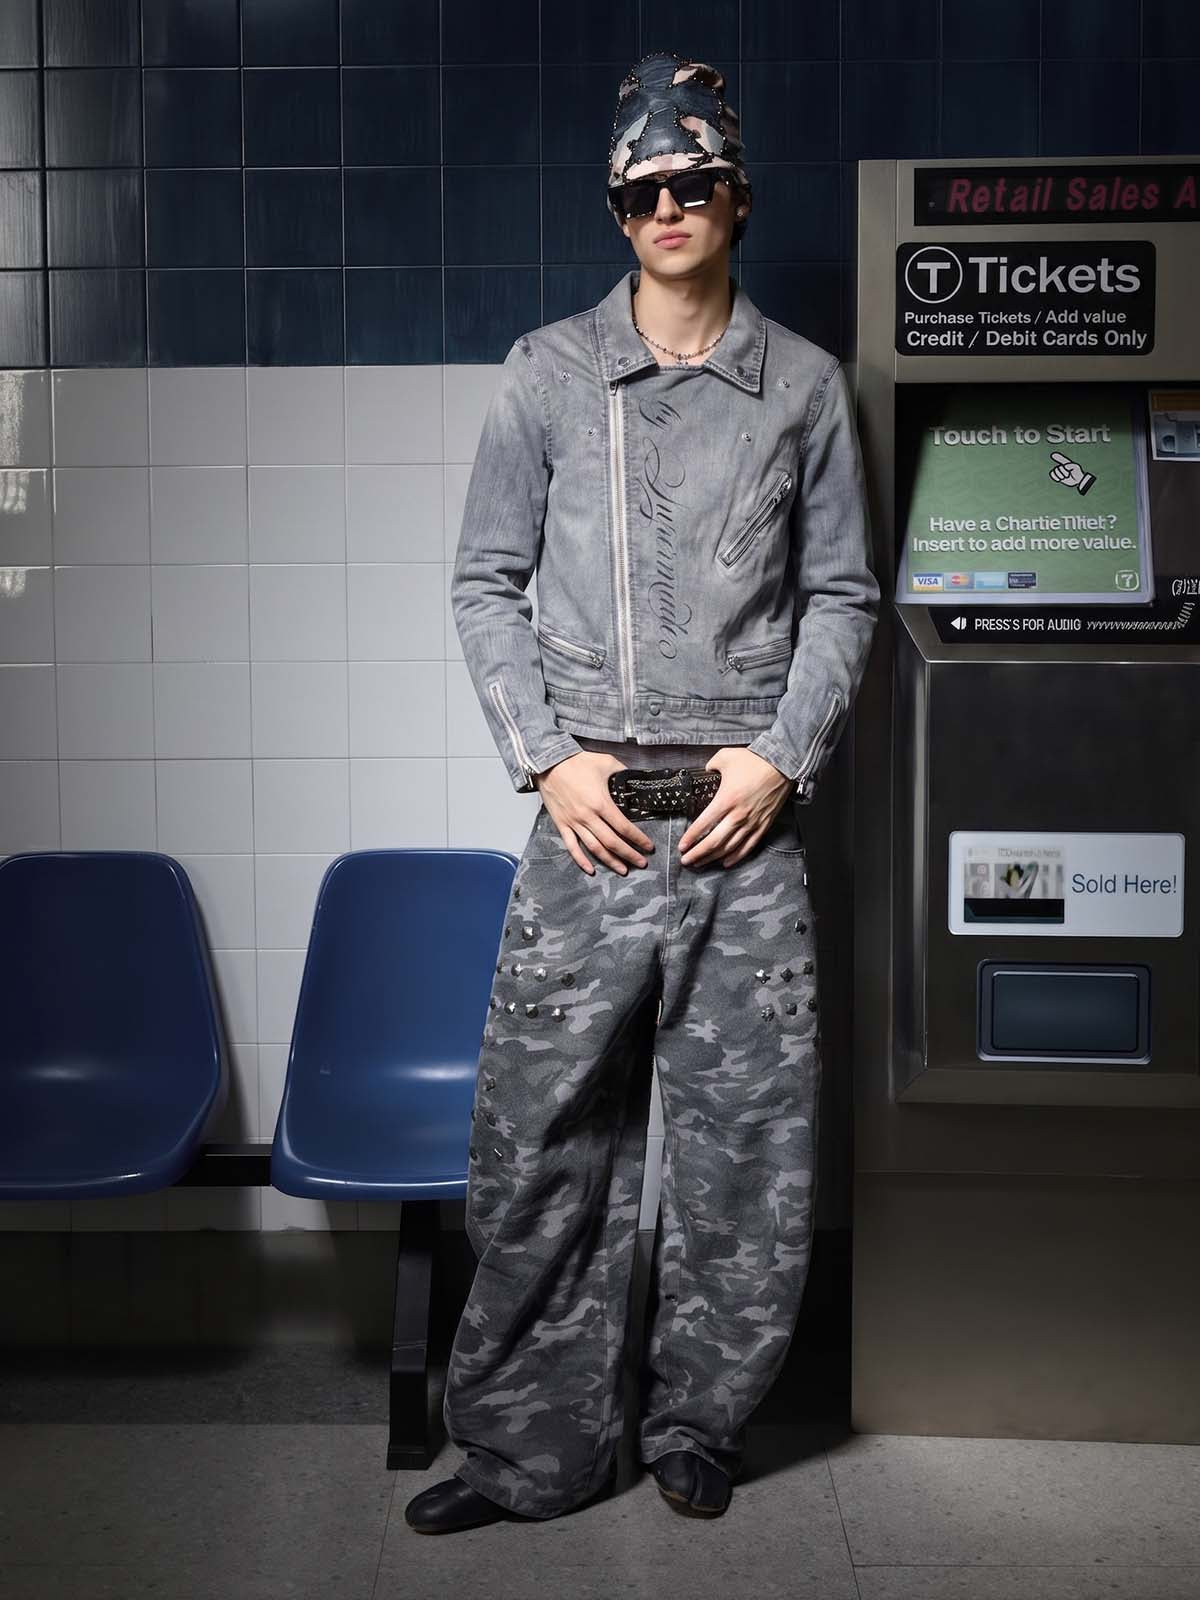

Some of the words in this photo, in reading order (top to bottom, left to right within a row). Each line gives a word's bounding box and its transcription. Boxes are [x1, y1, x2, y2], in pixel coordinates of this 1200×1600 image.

[947, 177, 1053, 213] Retail
[1066, 176, 1160, 211] Sales
[917, 262, 951, 294] T
[968, 256, 1141, 294] Tickets
[904, 311, 974, 325] Purchase
[978, 311, 1031, 324] Tickets
[1045, 310, 1079, 324] Add
[1084, 309, 1127, 324] value
[906, 331, 964, 347] Credit
[986, 331, 1037, 346] Debit
[1042, 330, 1099, 347] Cards
[1104, 329, 1147, 349] Only
[931, 426, 1008, 446] Touch
[1013, 425, 1041, 444] to
[1046, 424, 1111, 445] Start
[929, 516, 977, 532] Have
[980, 518, 991, 532] a
[912, 537, 966, 552] Insert
[969, 537, 987, 552] to
[991, 536, 1027, 551] add
[1030, 536, 1081, 551] more
[1083, 535, 1137, 551] value.
[917, 577, 940, 586] VISA
[1022, 618, 1045, 631] FOR
[1071, 873, 1117, 894] Sold
[1123, 874, 1178, 895] Here!
